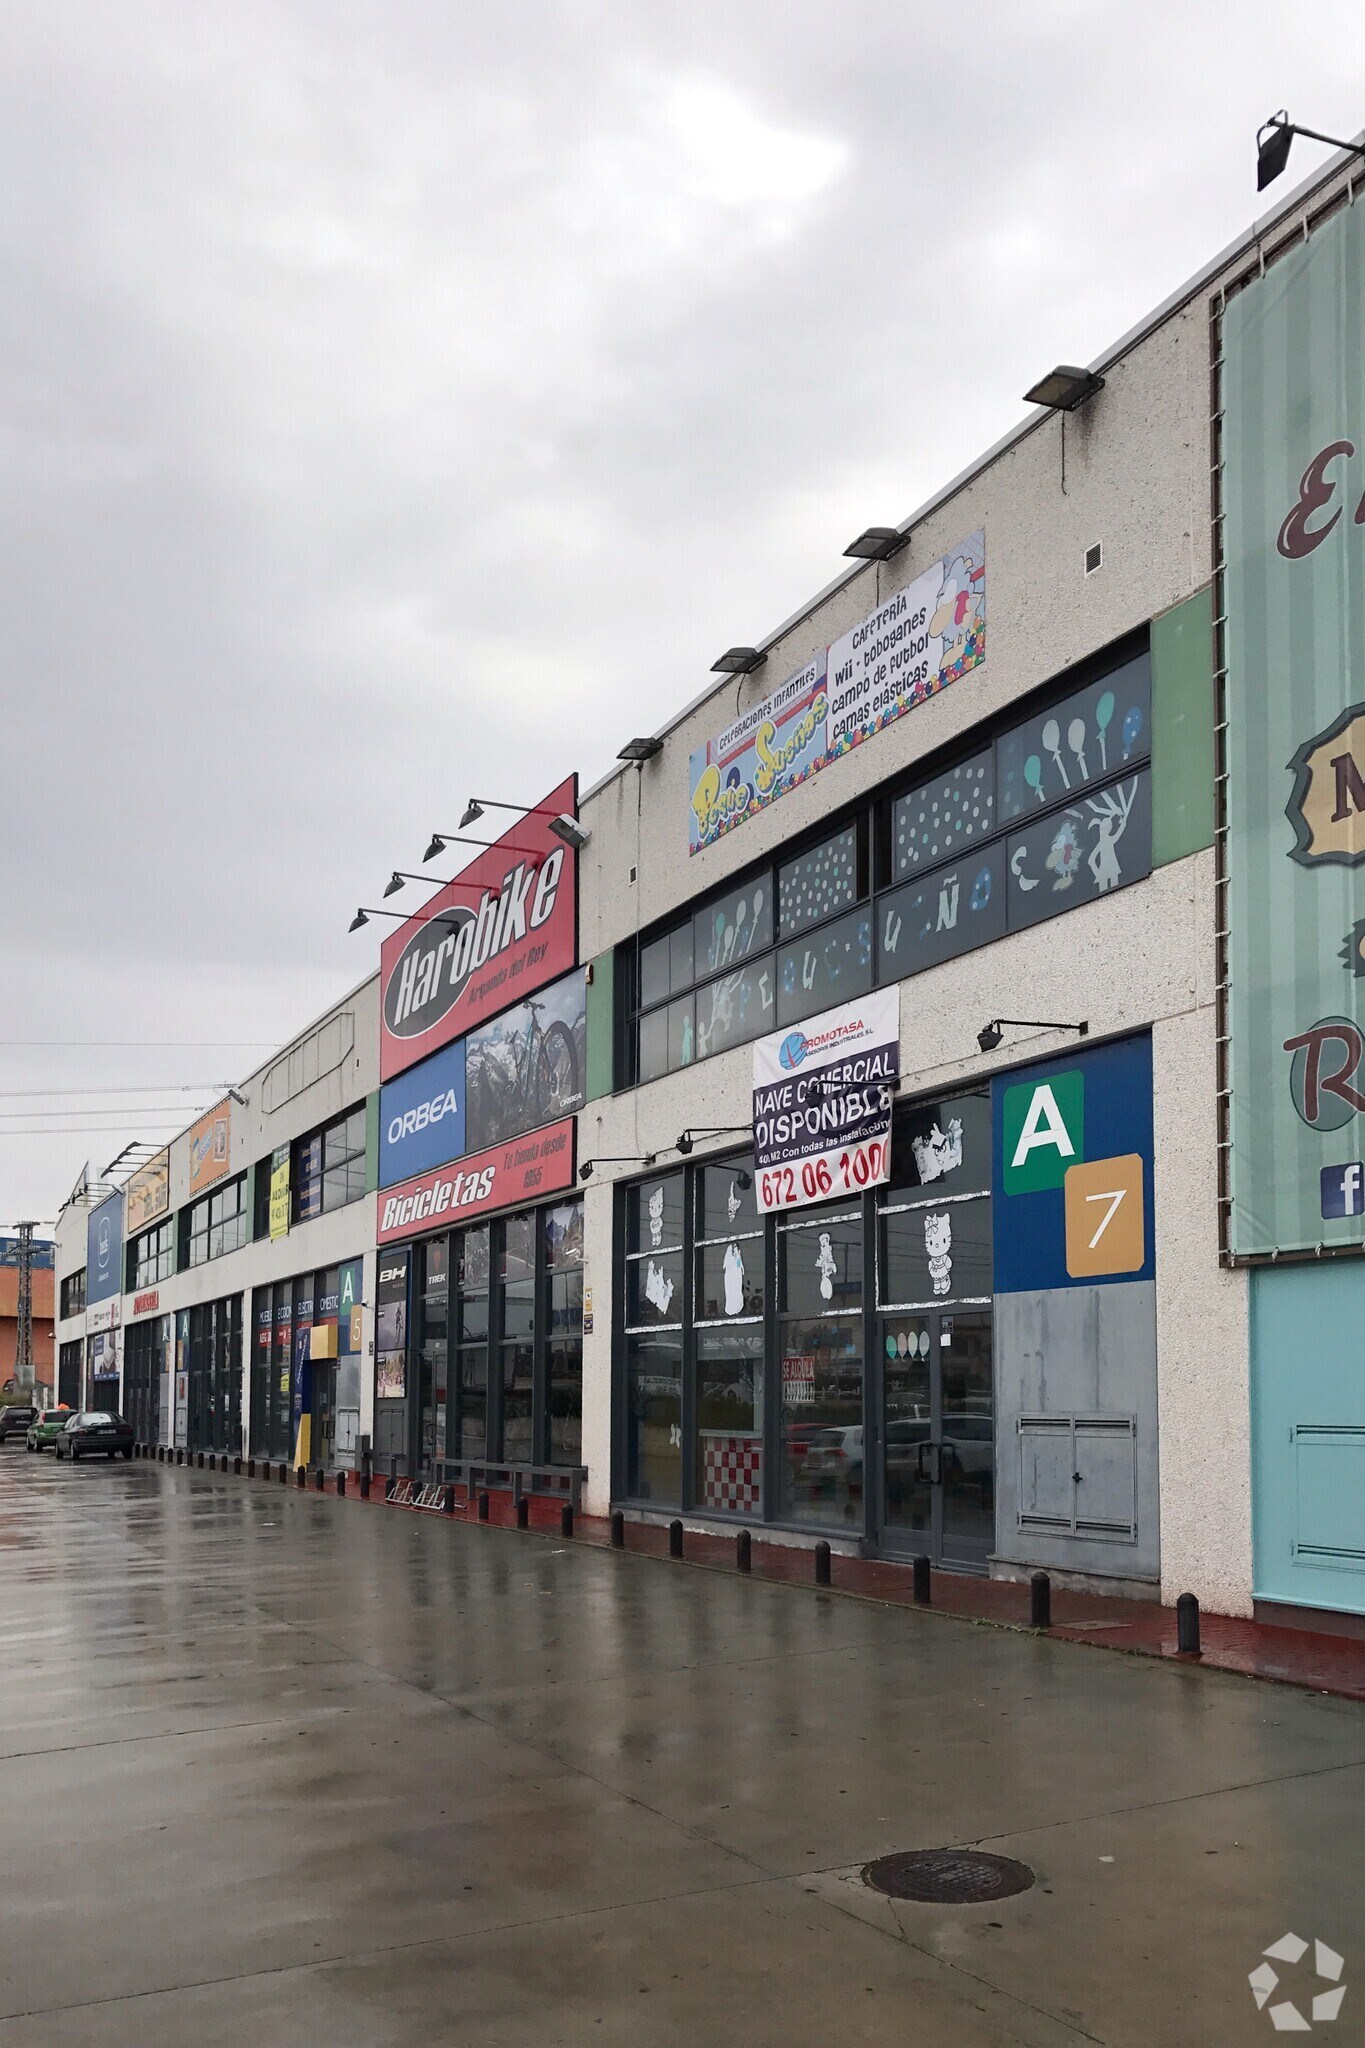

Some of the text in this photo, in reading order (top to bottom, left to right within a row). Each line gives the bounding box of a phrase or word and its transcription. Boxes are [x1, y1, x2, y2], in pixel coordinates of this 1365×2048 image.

[864, 607, 927, 667] toboganes
[832, 677, 870, 715] campo
[873, 663, 887, 685] de
[833, 660, 928, 739] camas elásticas
[392, 846, 565, 1027] Harobike
[526, 941, 549, 967] Rey
[800, 1019, 865, 1051] PROMOTASA
[560, 1092, 583, 1107] ORBEA
[755, 1052, 896, 1117] NAVE COMERCIAL
[388, 1089, 458, 1144] ORBEA
[1011, 1084, 1076, 1167] A
[514, 1142, 539, 1168] tienda
[540, 1132, 567, 1158] desde
[782, 1147, 799, 1159] Con
[801, 1141, 824, 1154] todas
[826, 1137, 838, 1148] las
[381, 1166, 497, 1233] Bicicletas
[762, 1168, 798, 1207] 672
[801, 1158, 833, 1198] 06
[1085, 1189, 1127, 1249] 7
[342, 1270, 353, 1304] A
[379, 1266, 407, 1283] BH
[428, 1273, 446, 1285] TREK
[352, 1318, 362, 1342] 5
